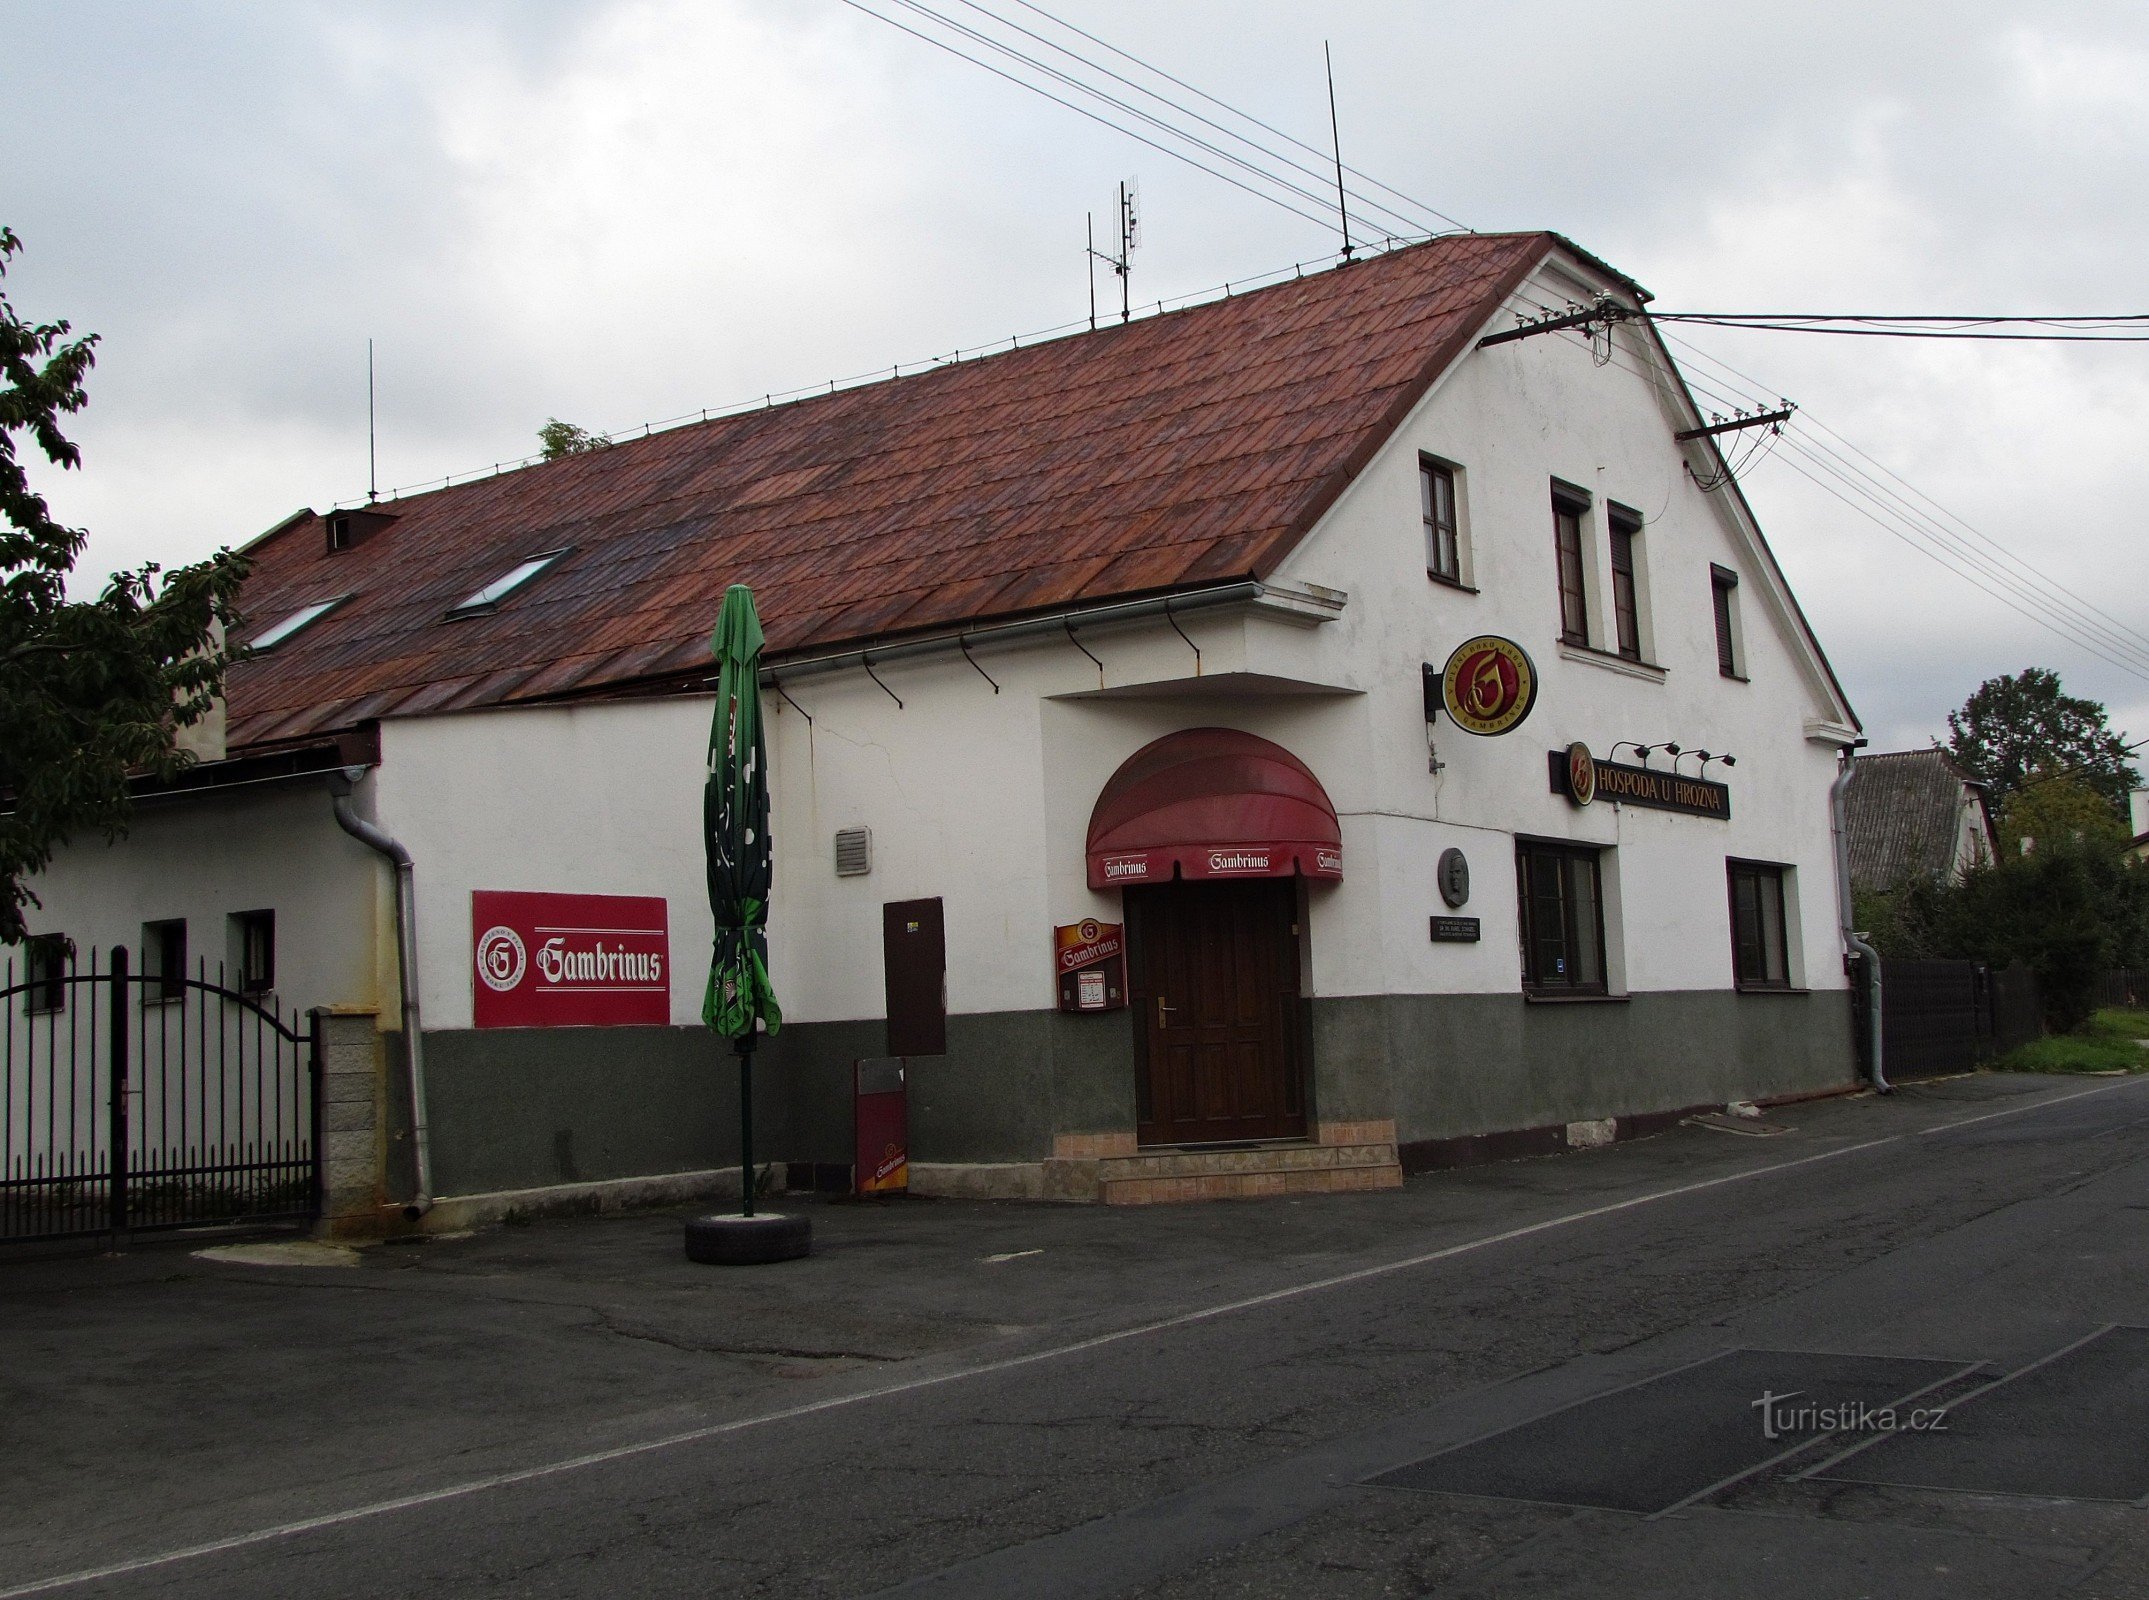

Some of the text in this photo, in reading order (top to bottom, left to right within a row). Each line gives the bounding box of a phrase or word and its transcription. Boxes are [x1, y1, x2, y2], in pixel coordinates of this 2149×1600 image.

[1463, 695, 1525, 729] GAMBRINUS
[1598, 767, 1721, 811] HOSPODA U HROZNA
[1104, 860, 1147, 878] Gambrinus
[1210, 853, 1269, 870] Gambrinus
[536, 937, 662, 983] Gambrinus
[1063, 939, 1119, 967] Gambrinus
